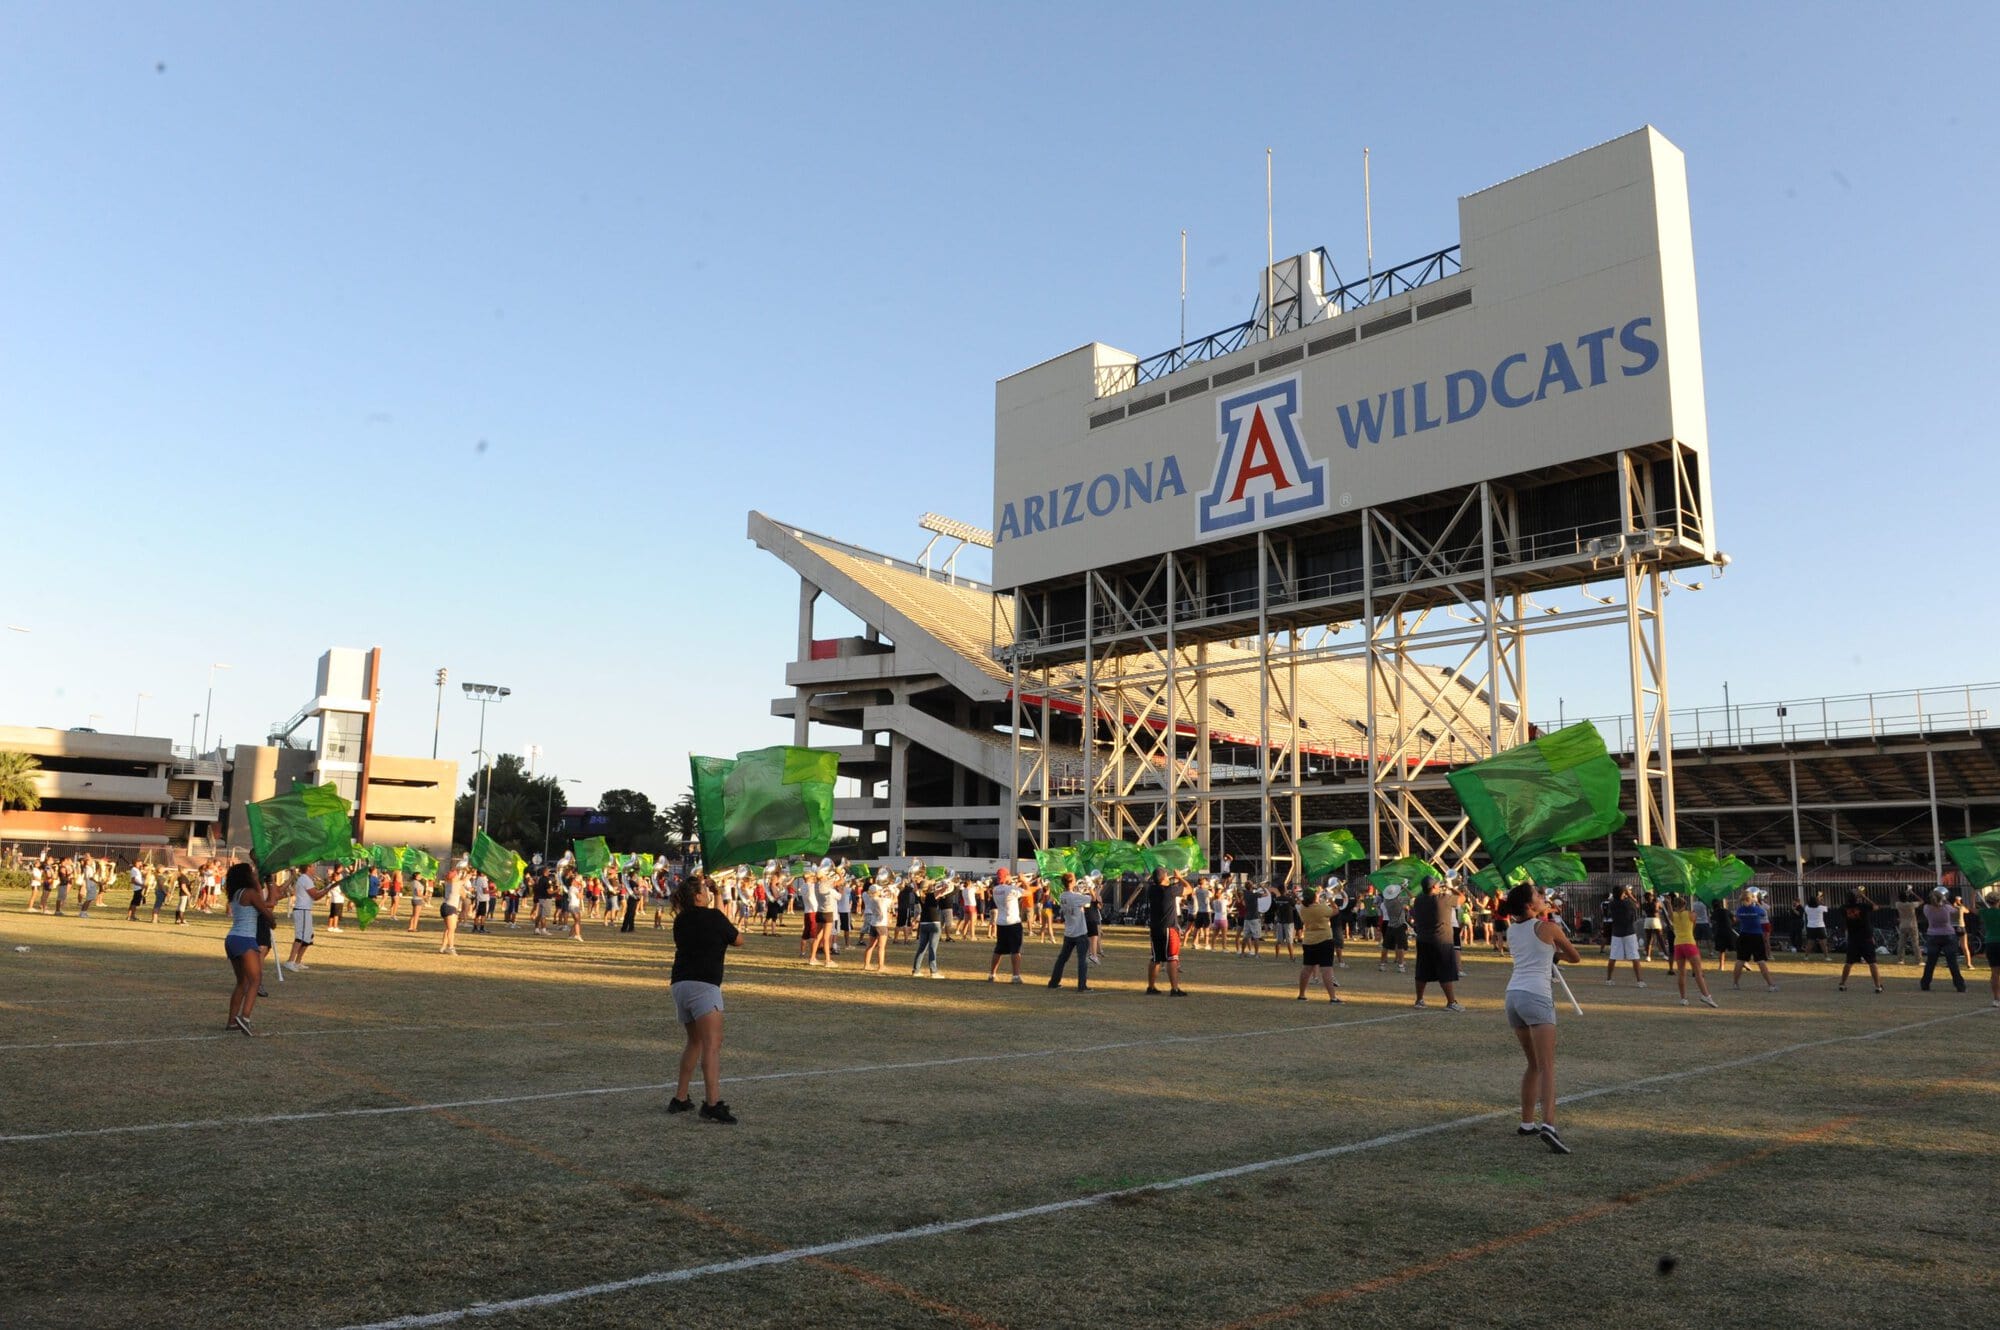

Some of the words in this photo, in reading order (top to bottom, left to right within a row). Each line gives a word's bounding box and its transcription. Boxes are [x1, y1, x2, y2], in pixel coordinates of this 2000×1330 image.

[996, 455, 1187, 543] ARIZONA
[1197, 373, 1327, 538] A
[1336, 317, 1660, 449] WILDCATS
